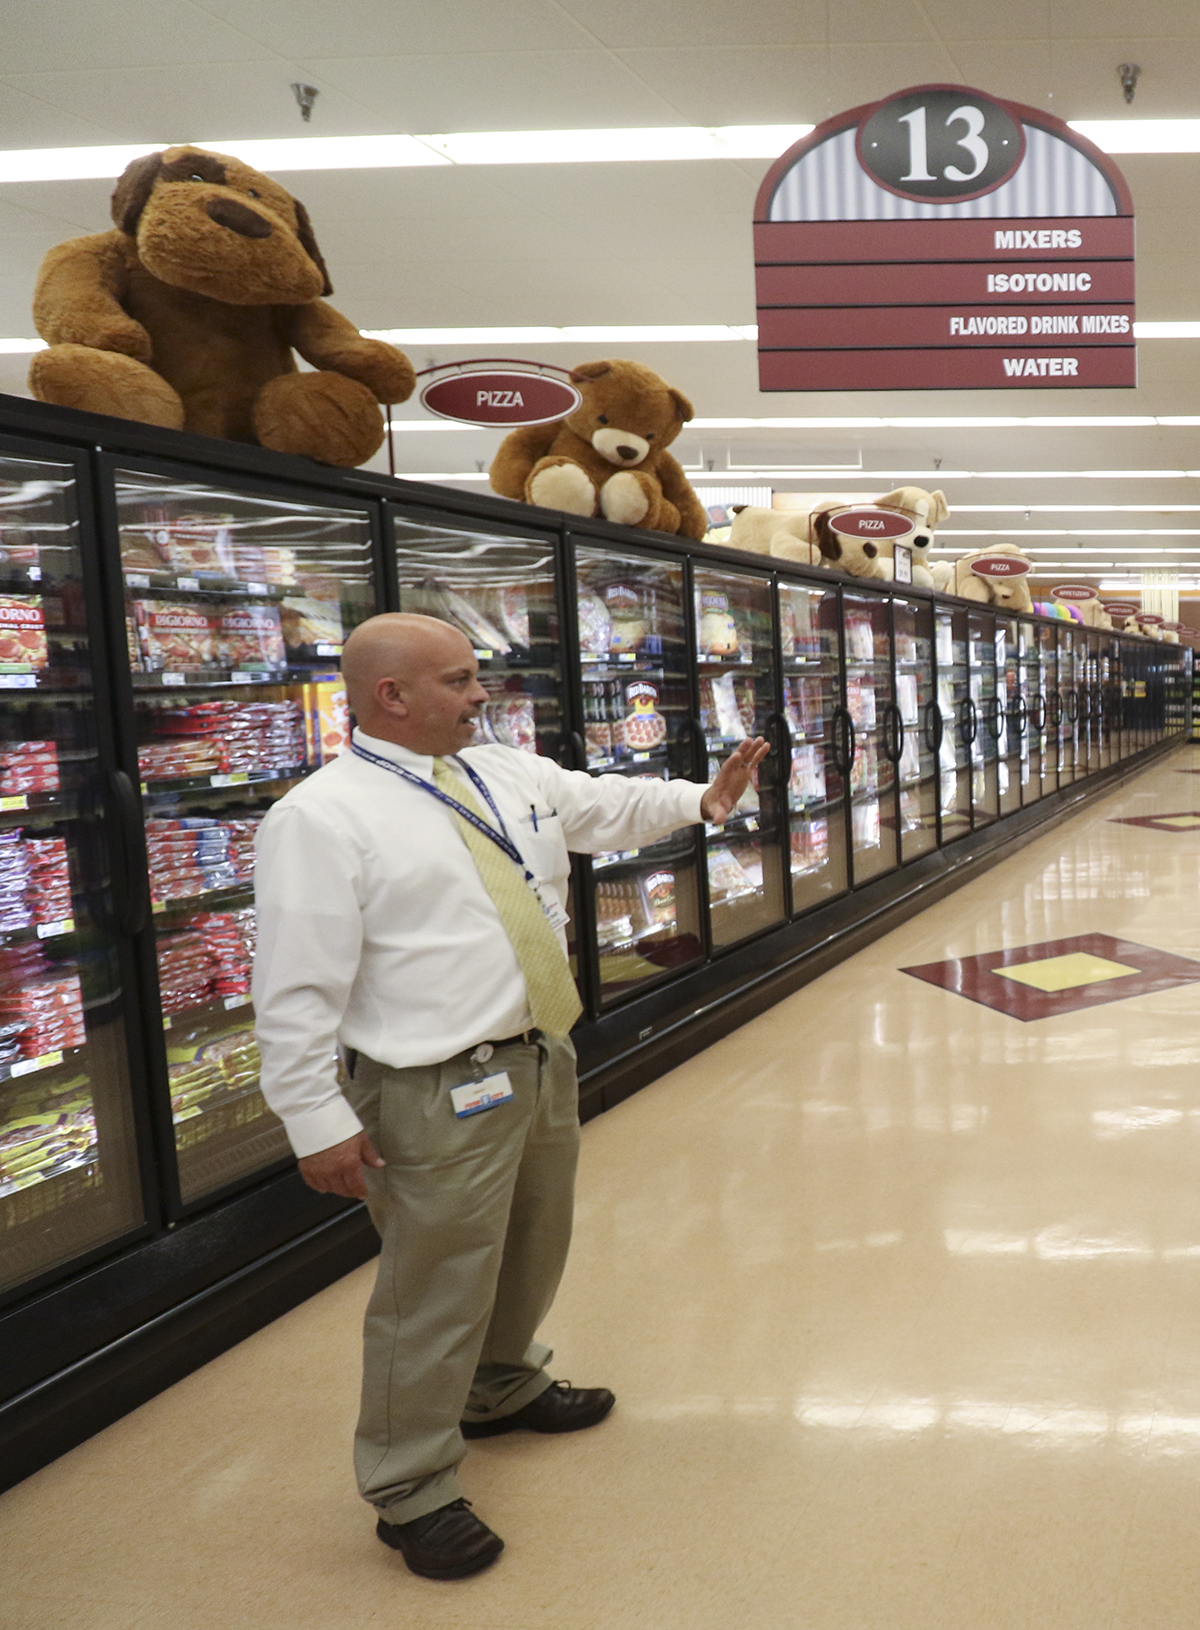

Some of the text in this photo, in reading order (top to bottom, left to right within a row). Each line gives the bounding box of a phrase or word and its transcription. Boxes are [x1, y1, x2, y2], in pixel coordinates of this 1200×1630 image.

[898, 105, 990, 182] 13
[994, 230, 1082, 249] MIXERS
[987, 273, 1091, 293] ISOTONIC
[950, 315, 1129, 336] FLAVORED DRINK MIXES
[1003, 358, 1078, 377] WATER
[476, 390, 524, 407] PIZZA
[858, 519, 885, 531] PIZZA
[990, 563, 1010, 571] PIZZA
[628, 683, 658, 698] RED BARON
